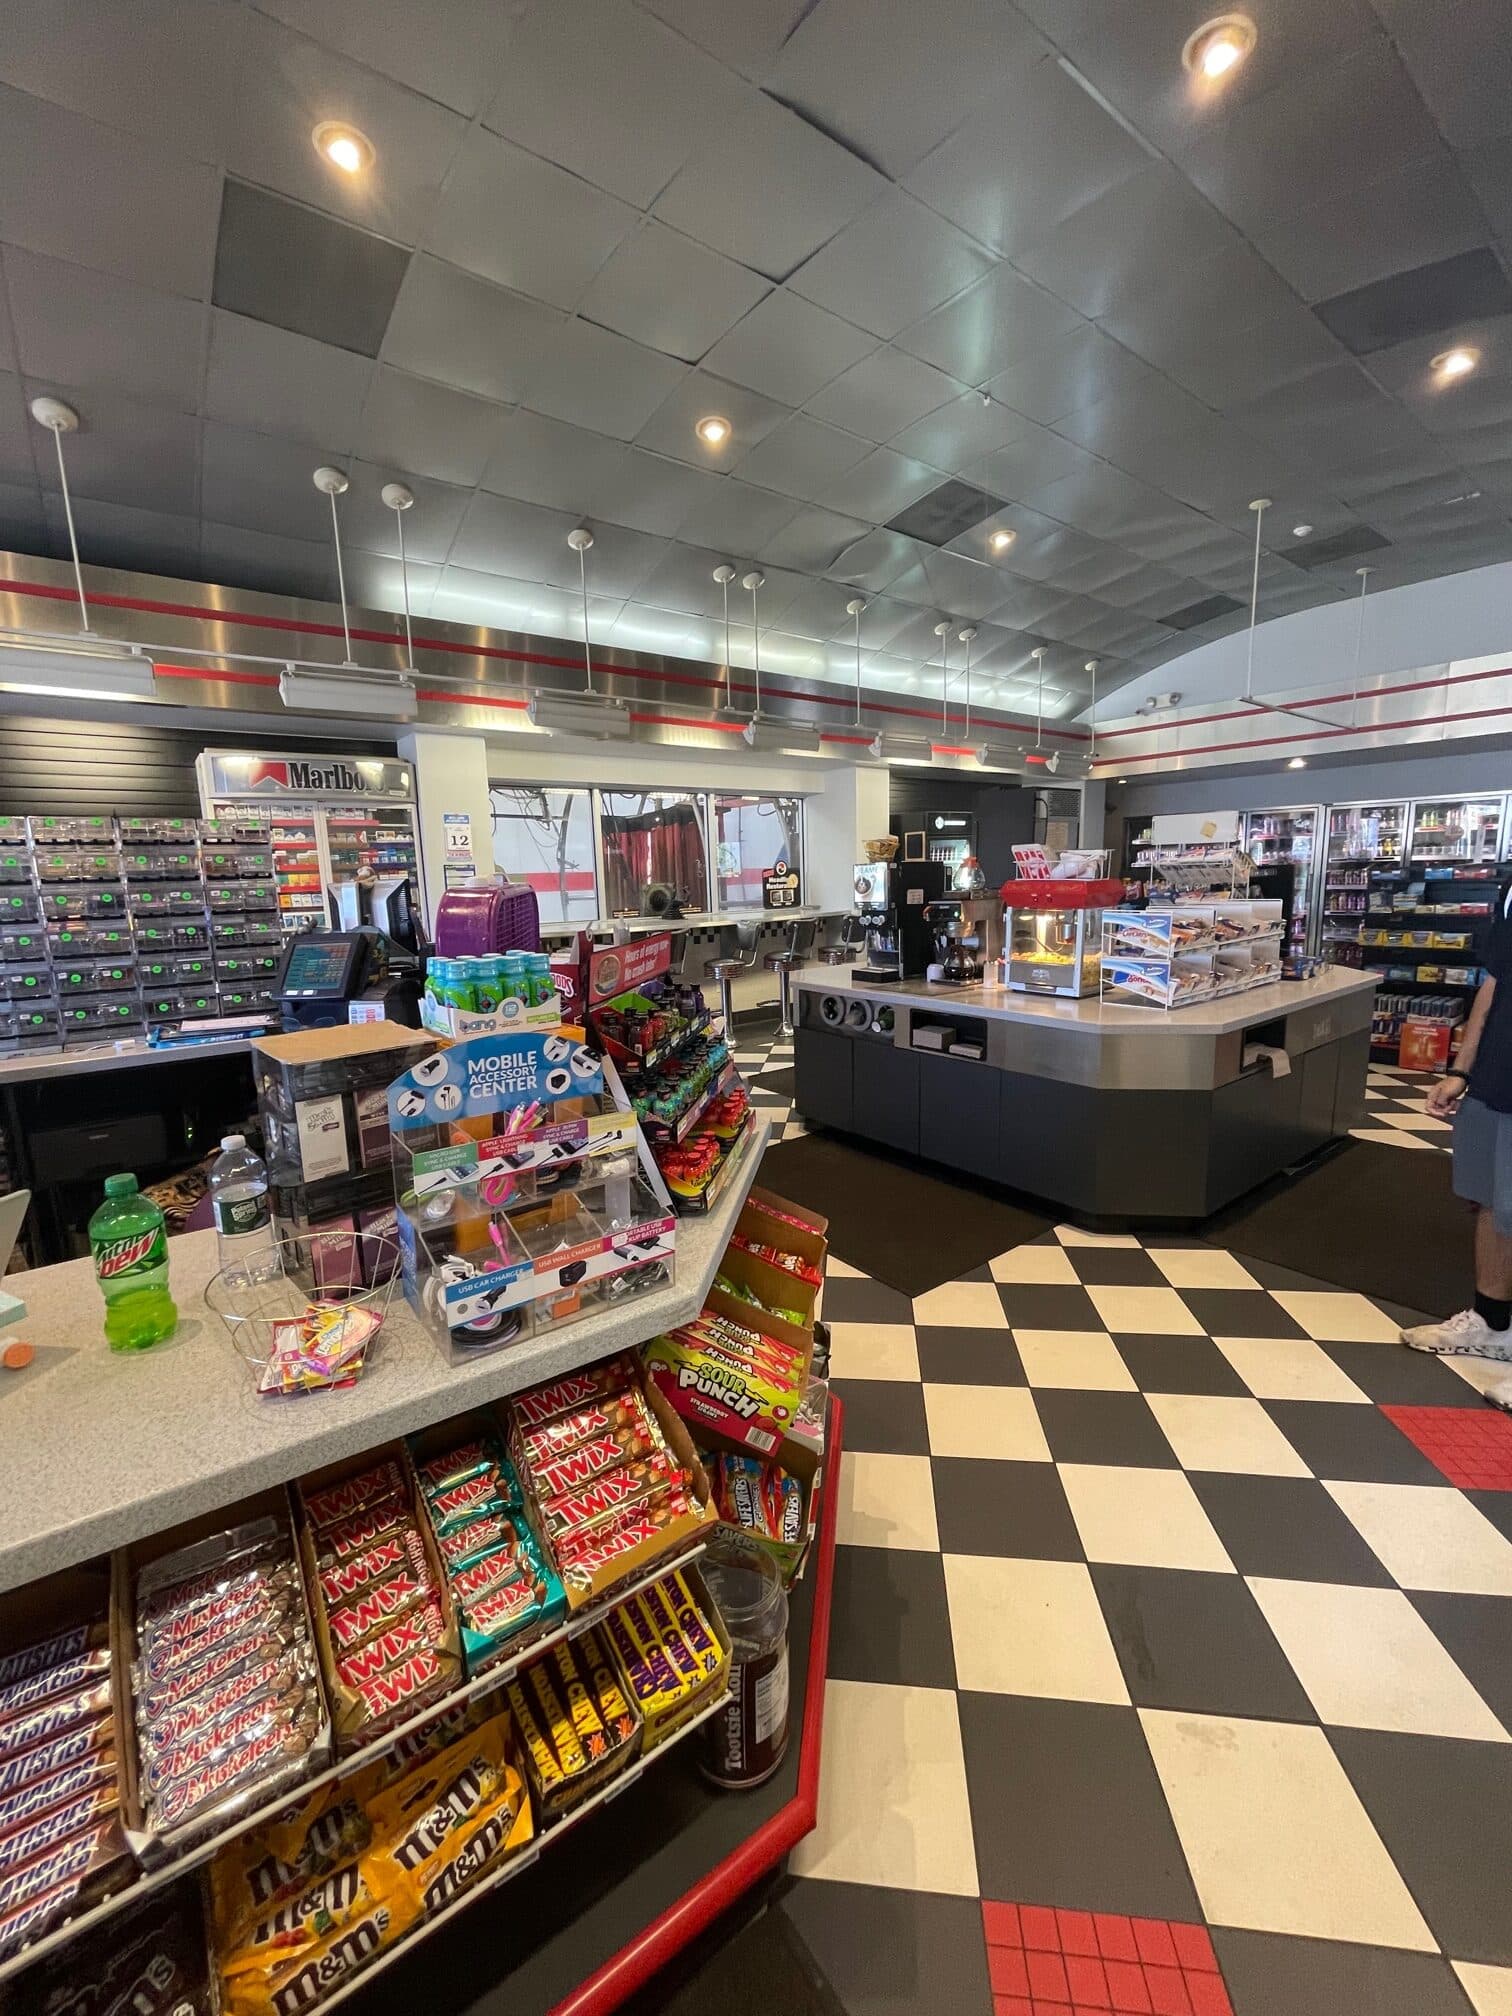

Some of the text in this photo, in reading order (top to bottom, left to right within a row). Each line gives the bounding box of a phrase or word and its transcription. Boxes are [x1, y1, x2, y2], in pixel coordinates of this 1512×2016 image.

[451, 835, 469, 847] 12
[459, 1019, 497, 1033] bang
[468, 1051, 537, 1074] MOBILE
[469, 1065, 537, 1086] ACCESSORY
[469, 1076, 538, 1099] CENTER
[626, 1224, 653, 1237] ORTABLE
[458, 1282, 473, 1294] USB
[473, 1277, 491, 1290] CAR
[705, 1347, 753, 1374] PUNCH
[709, 1328, 755, 1356] PUNCH
[514, 1373, 598, 1424] TWIX
[679, 1367, 760, 1418] PUNCH
[700, 1363, 746, 1395] SOUR
[523, 1405, 608, 1461] TWIX
[689, 1397, 729, 1418] STRAWBERRY
[532, 1434, 623, 1494] TWIX
[304, 1468, 388, 1528] TWIX
[433, 1475, 495, 1514] TWIX
[547, 1470, 642, 1526] TWIX
[784, 1495, 800, 1532] SAVERS
[319, 1502, 408, 1558] TWIX
[319, 1539, 405, 1604] TWIX
[452, 1549, 516, 1599] TWIX
[171, 1577, 269, 1637] Musketeers
[328, 1571, 418, 1648] TWIX
[465, 1579, 533, 1628] TWIX
[167, 1632, 270, 1704] Musketeers
[336, 1619, 426, 1690] TWIX
[153, 1660, 279, 1751] 3 Musketeers
[568, 1682, 604, 1737] CHEW
[594, 1667, 629, 1721] CHEW
[171, 1696, 279, 1777] Musketeers
[725, 1703, 742, 1771] Tootsie
[185, 1723, 294, 1808] Musketeers
